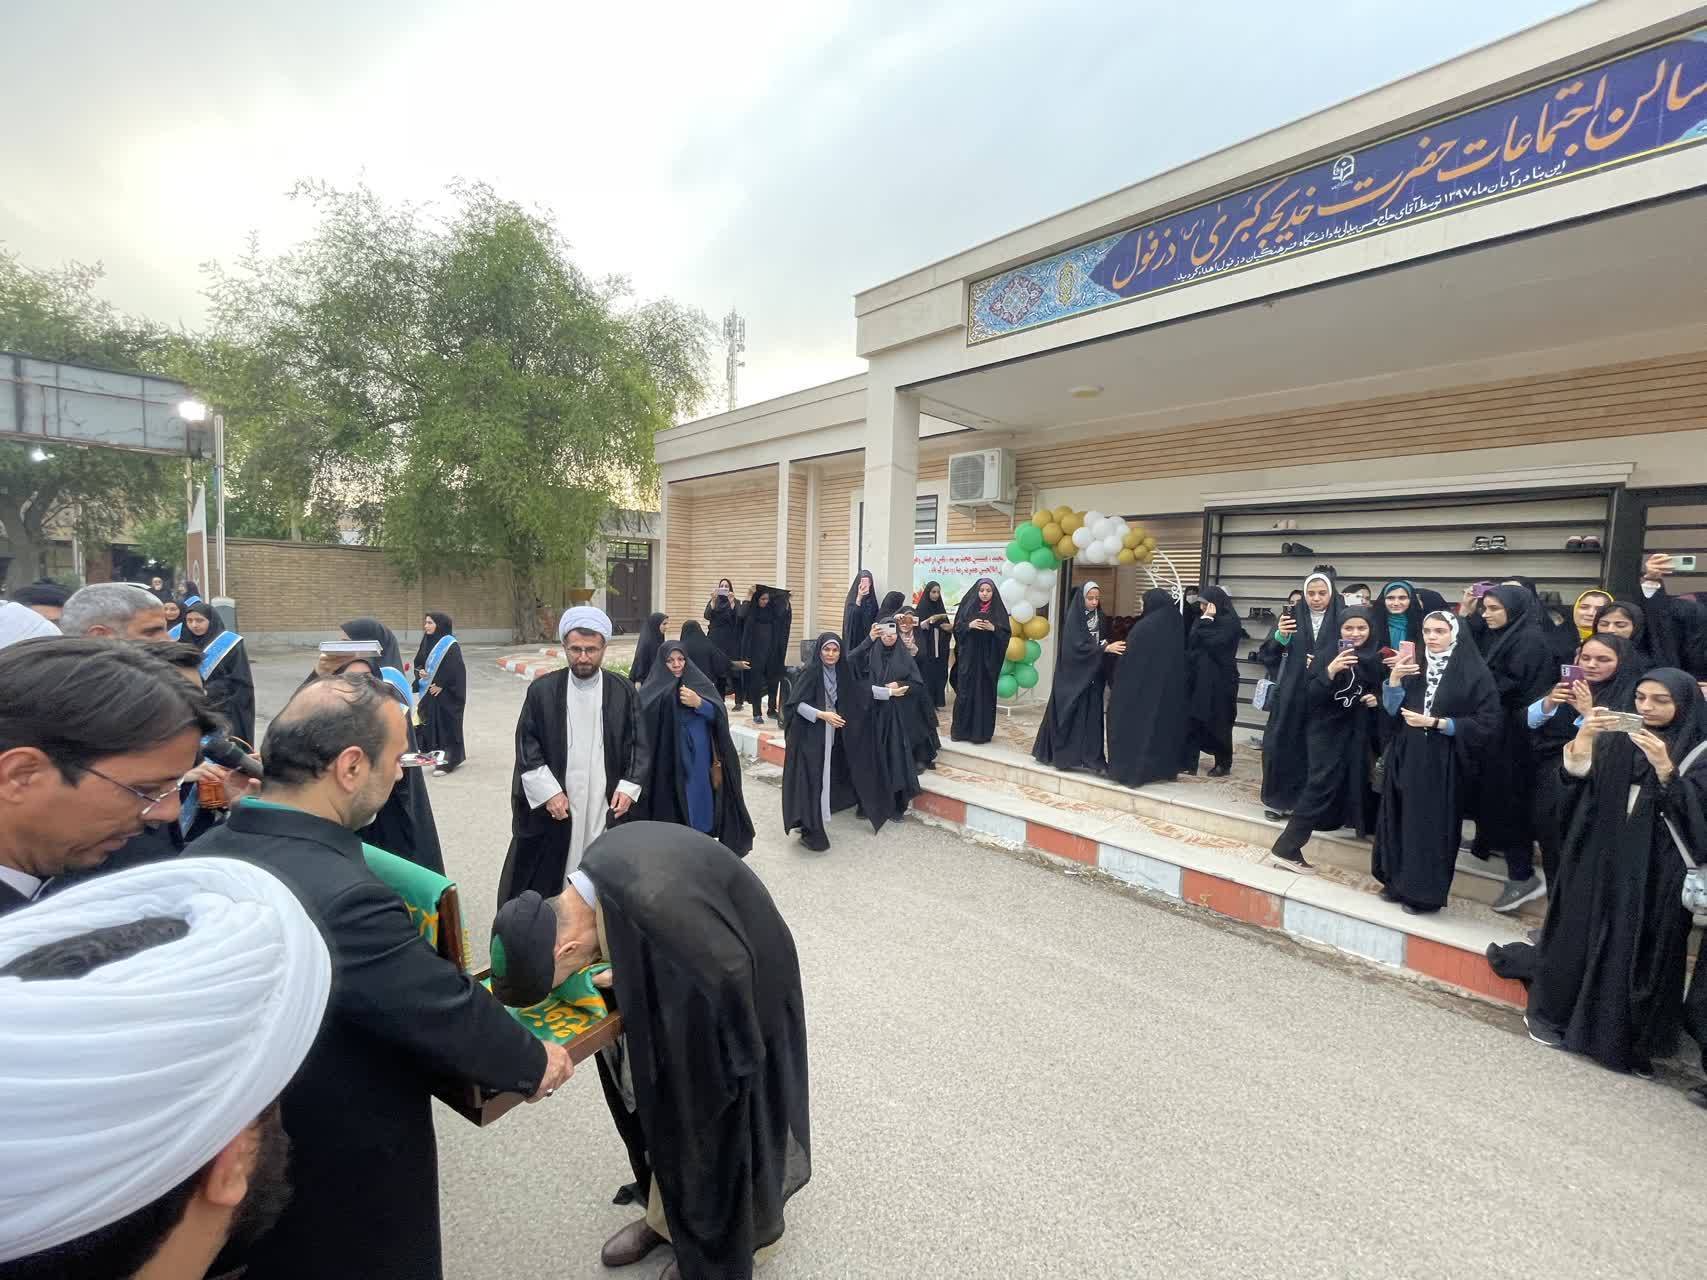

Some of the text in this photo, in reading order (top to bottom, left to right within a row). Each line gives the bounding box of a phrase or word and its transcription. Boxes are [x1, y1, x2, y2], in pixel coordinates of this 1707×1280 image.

[1437, 73, 1608, 183] اجتماعات
[1317, 136, 1460, 216] حضرت
[1532, 166, 1546, 180] بنا
[1545, 160, 1567, 178] این
[1472, 182, 1488, 196] ماه
[1488, 168, 1520, 194] آبان
[1512, 174, 1530, 188] در
[1395, 195, 1421, 221] آقای
[1415, 195, 1442, 213] توسط
[1256, 186, 1316, 249] خدیجه
[1377, 208, 1396, 226] حاج
[1299, 228, 1333, 247] دانشگاه
[1111, 227, 1177, 290] دزفول
[1245, 241, 1297, 264] فرهنگیان
[1217, 256, 1245, 272] دزفول
